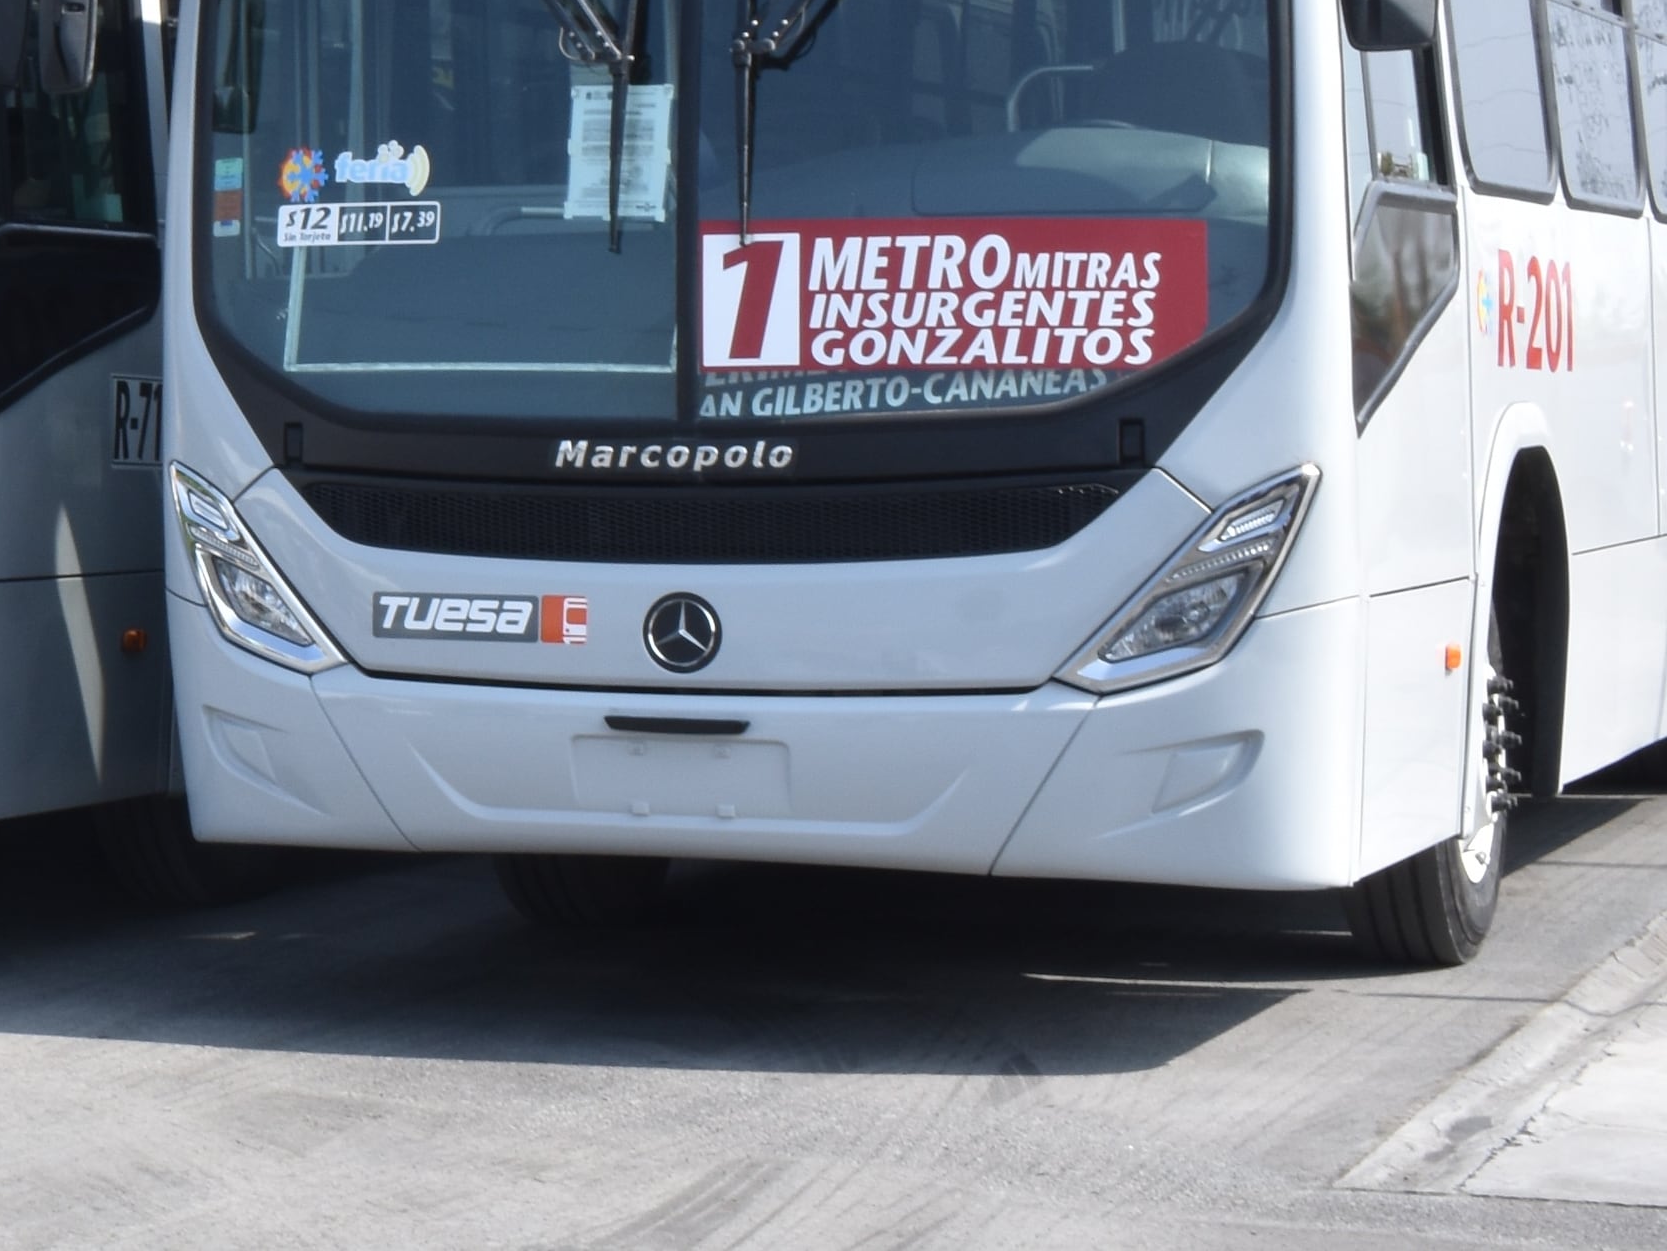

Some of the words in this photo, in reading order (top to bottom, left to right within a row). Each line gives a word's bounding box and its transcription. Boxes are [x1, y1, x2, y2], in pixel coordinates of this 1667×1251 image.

[336, 151, 410, 183] feria
[286, 207, 331, 230] $12
[391, 211, 435, 234] $7.39
[722, 239, 784, 360] 1
[808, 234, 1011, 291] METRO
[1014, 251, 1161, 290] MITRAS
[809, 290, 1155, 330] INSURGENTES
[1496, 248, 1575, 373] R-201
[811, 328, 1155, 367] GONZALITOS
[554, 439, 794, 472] Marcopolo
